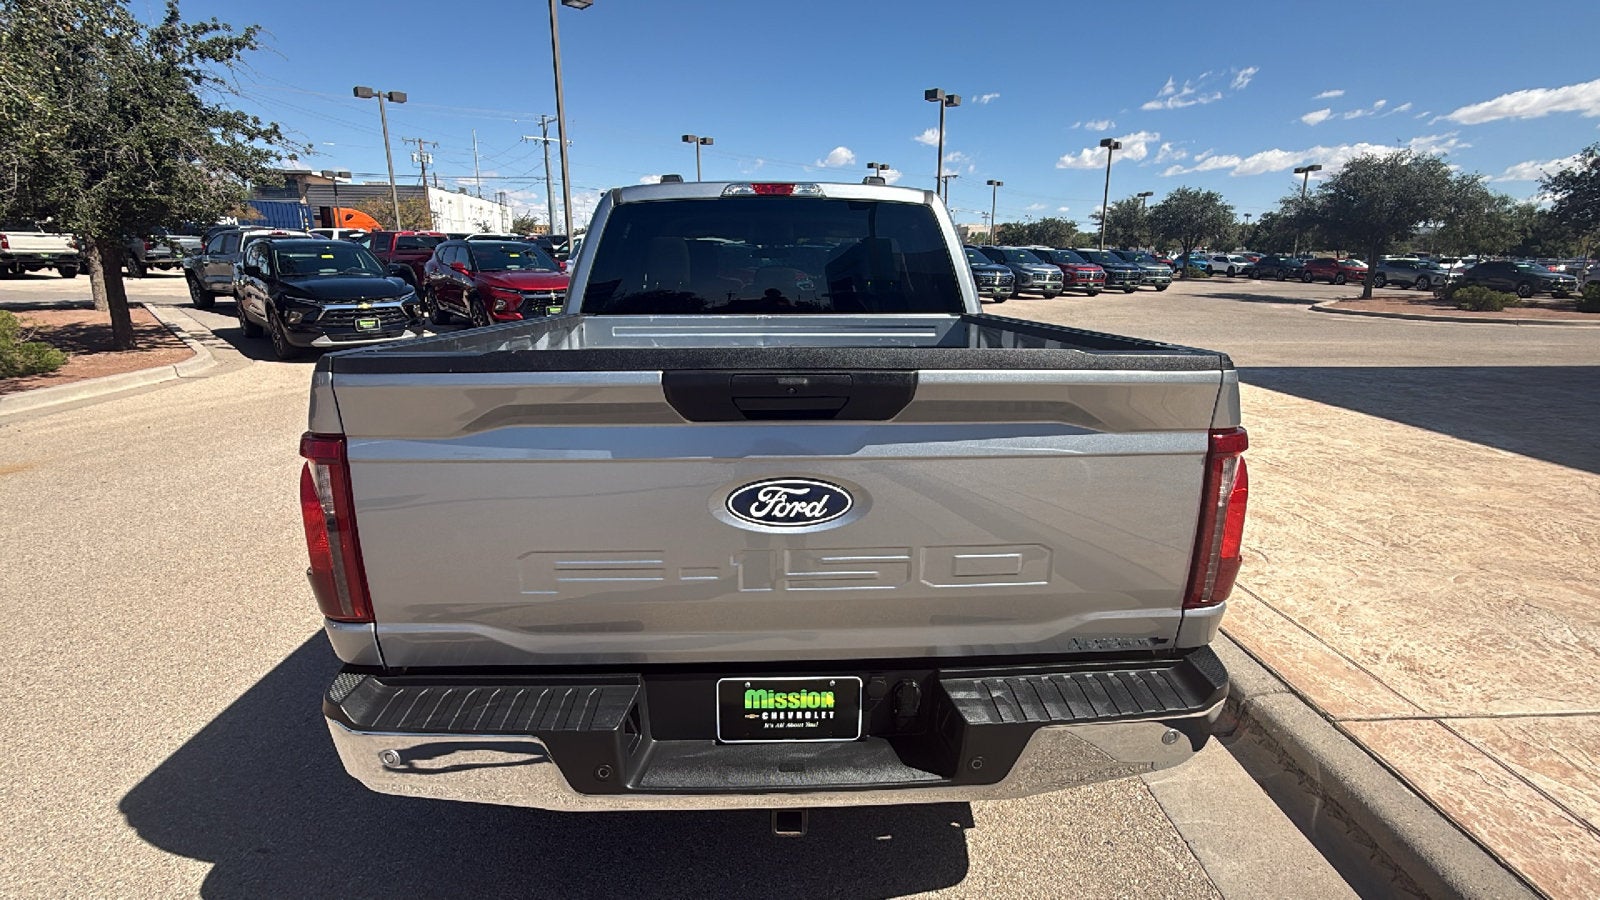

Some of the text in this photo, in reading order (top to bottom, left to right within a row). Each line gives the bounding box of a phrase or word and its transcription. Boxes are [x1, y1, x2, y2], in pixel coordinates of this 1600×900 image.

[750, 486, 829, 517] Ford
[518, 545, 1053, 594] F-150
[744, 689, 835, 708] Mission
[761, 711, 835, 720] CHEVROLET
